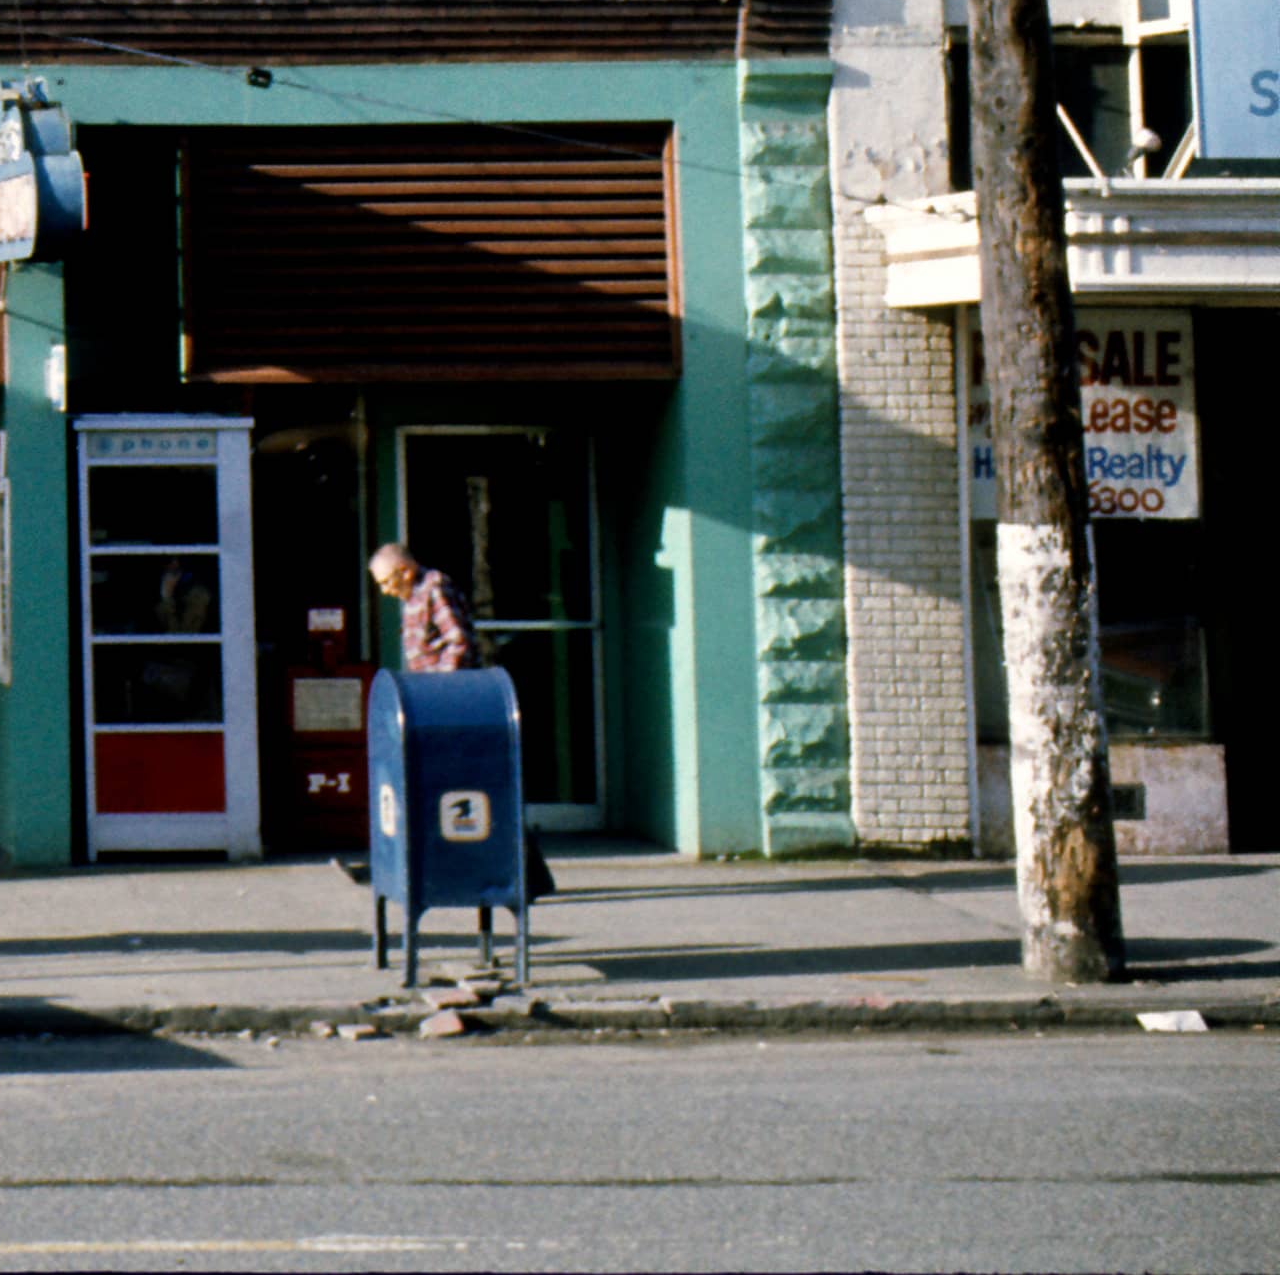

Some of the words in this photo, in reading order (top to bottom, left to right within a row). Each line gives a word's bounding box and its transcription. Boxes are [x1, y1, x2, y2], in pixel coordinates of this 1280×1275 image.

[1075, 329, 1182, 386] SALE
[1082, 397, 1177, 434] ease
[122, 437, 210, 453] phone
[1087, 443, 1187, 487] Realty
[307, 773, 351, 793] P-I
